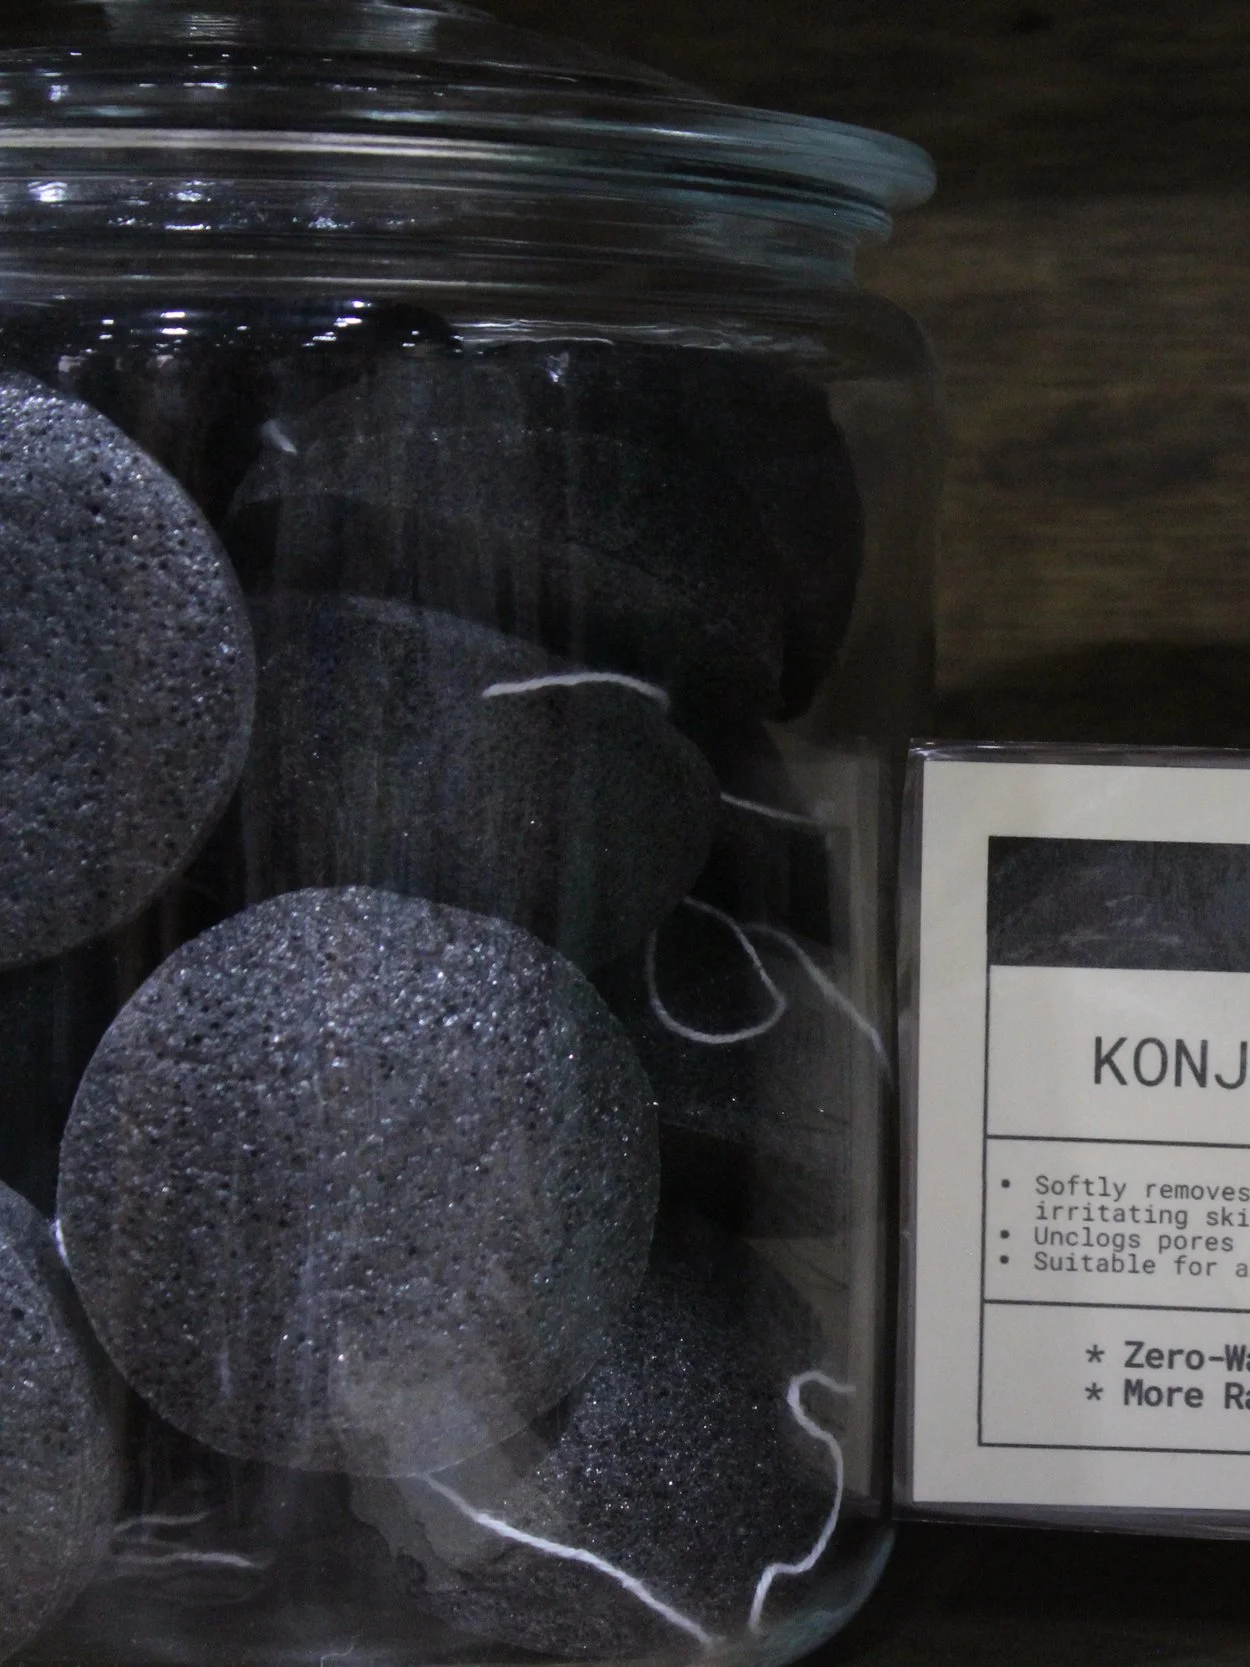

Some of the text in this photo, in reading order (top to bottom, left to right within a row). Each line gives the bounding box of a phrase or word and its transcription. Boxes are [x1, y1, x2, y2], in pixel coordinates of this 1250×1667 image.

[1035, 1175, 1127, 1200] Softly
[1145, 1182, 1250, 1202] removes
[1035, 1201, 1189, 1228] irritating
[1034, 1226, 1141, 1251] Unclogs
[1158, 1234, 1235, 1254] pores
[1034, 1251, 1156, 1275] Suitable
[1174, 1255, 1217, 1277] for
[1123, 1379, 1205, 1409] More
